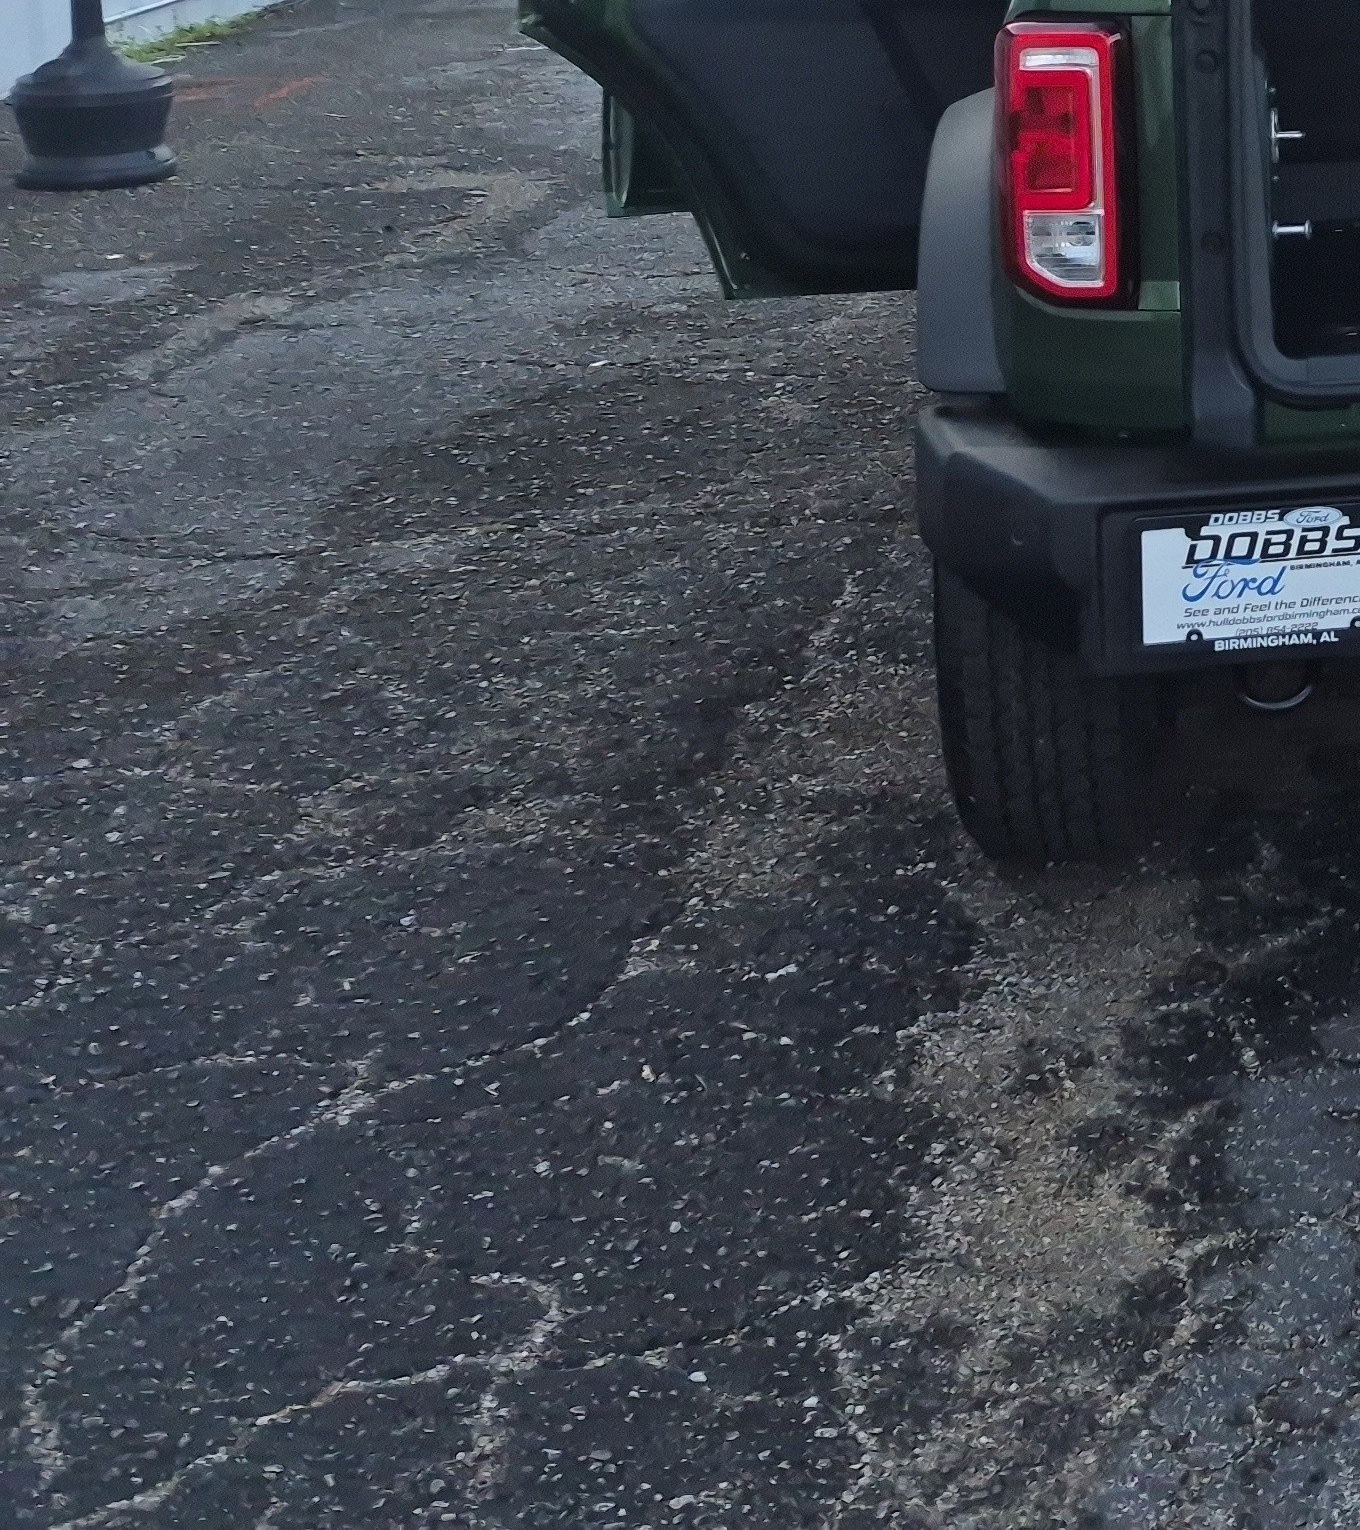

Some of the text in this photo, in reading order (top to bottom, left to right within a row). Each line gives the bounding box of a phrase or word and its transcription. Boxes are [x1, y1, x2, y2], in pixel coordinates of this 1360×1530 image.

[1208, 509, 1281, 526] DOBBS
[1181, 558, 1288, 603] Ford
[1184, 607, 1209, 618] See
[1213, 604, 1240, 616] and
[1243, 601, 1272, 613] Feel
[1274, 600, 1297, 611] the
[1214, 631, 1339, 652] BIRMINGHAM, AL
